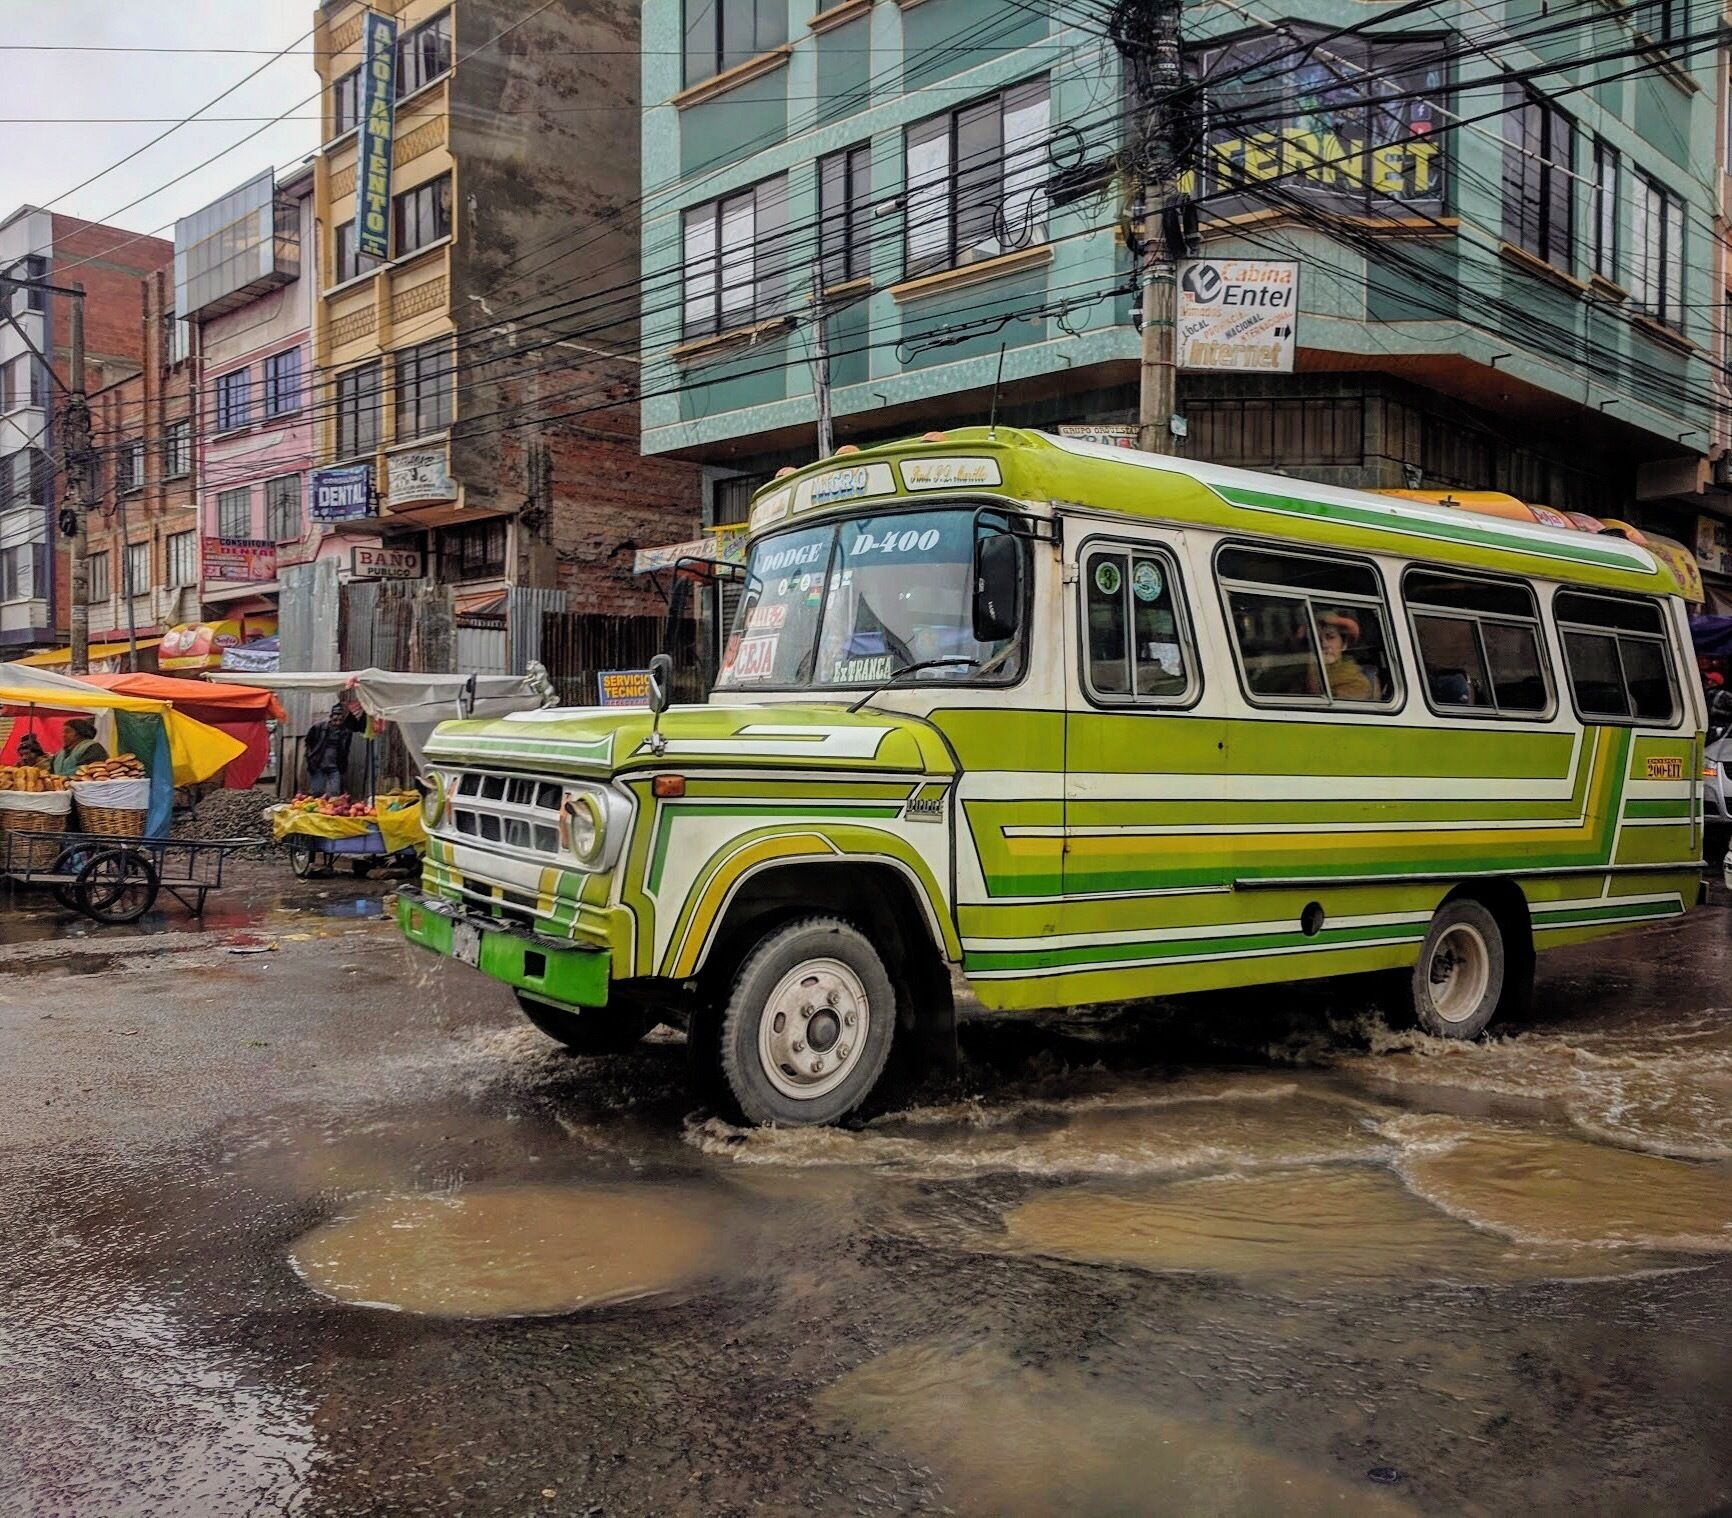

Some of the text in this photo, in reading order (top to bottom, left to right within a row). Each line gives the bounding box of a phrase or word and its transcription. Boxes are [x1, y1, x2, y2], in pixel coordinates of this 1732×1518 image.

[1176, 128, 1439, 193] TERNET
[1222, 285, 1293, 308] Entel
[319, 482, 366, 507] DENTAL
[849, 529, 940, 556] D-400
[360, 551, 417, 569] BAÑO
[761, 543, 823, 573] DODGE
[603, 673, 650, 687] SERVICIO
